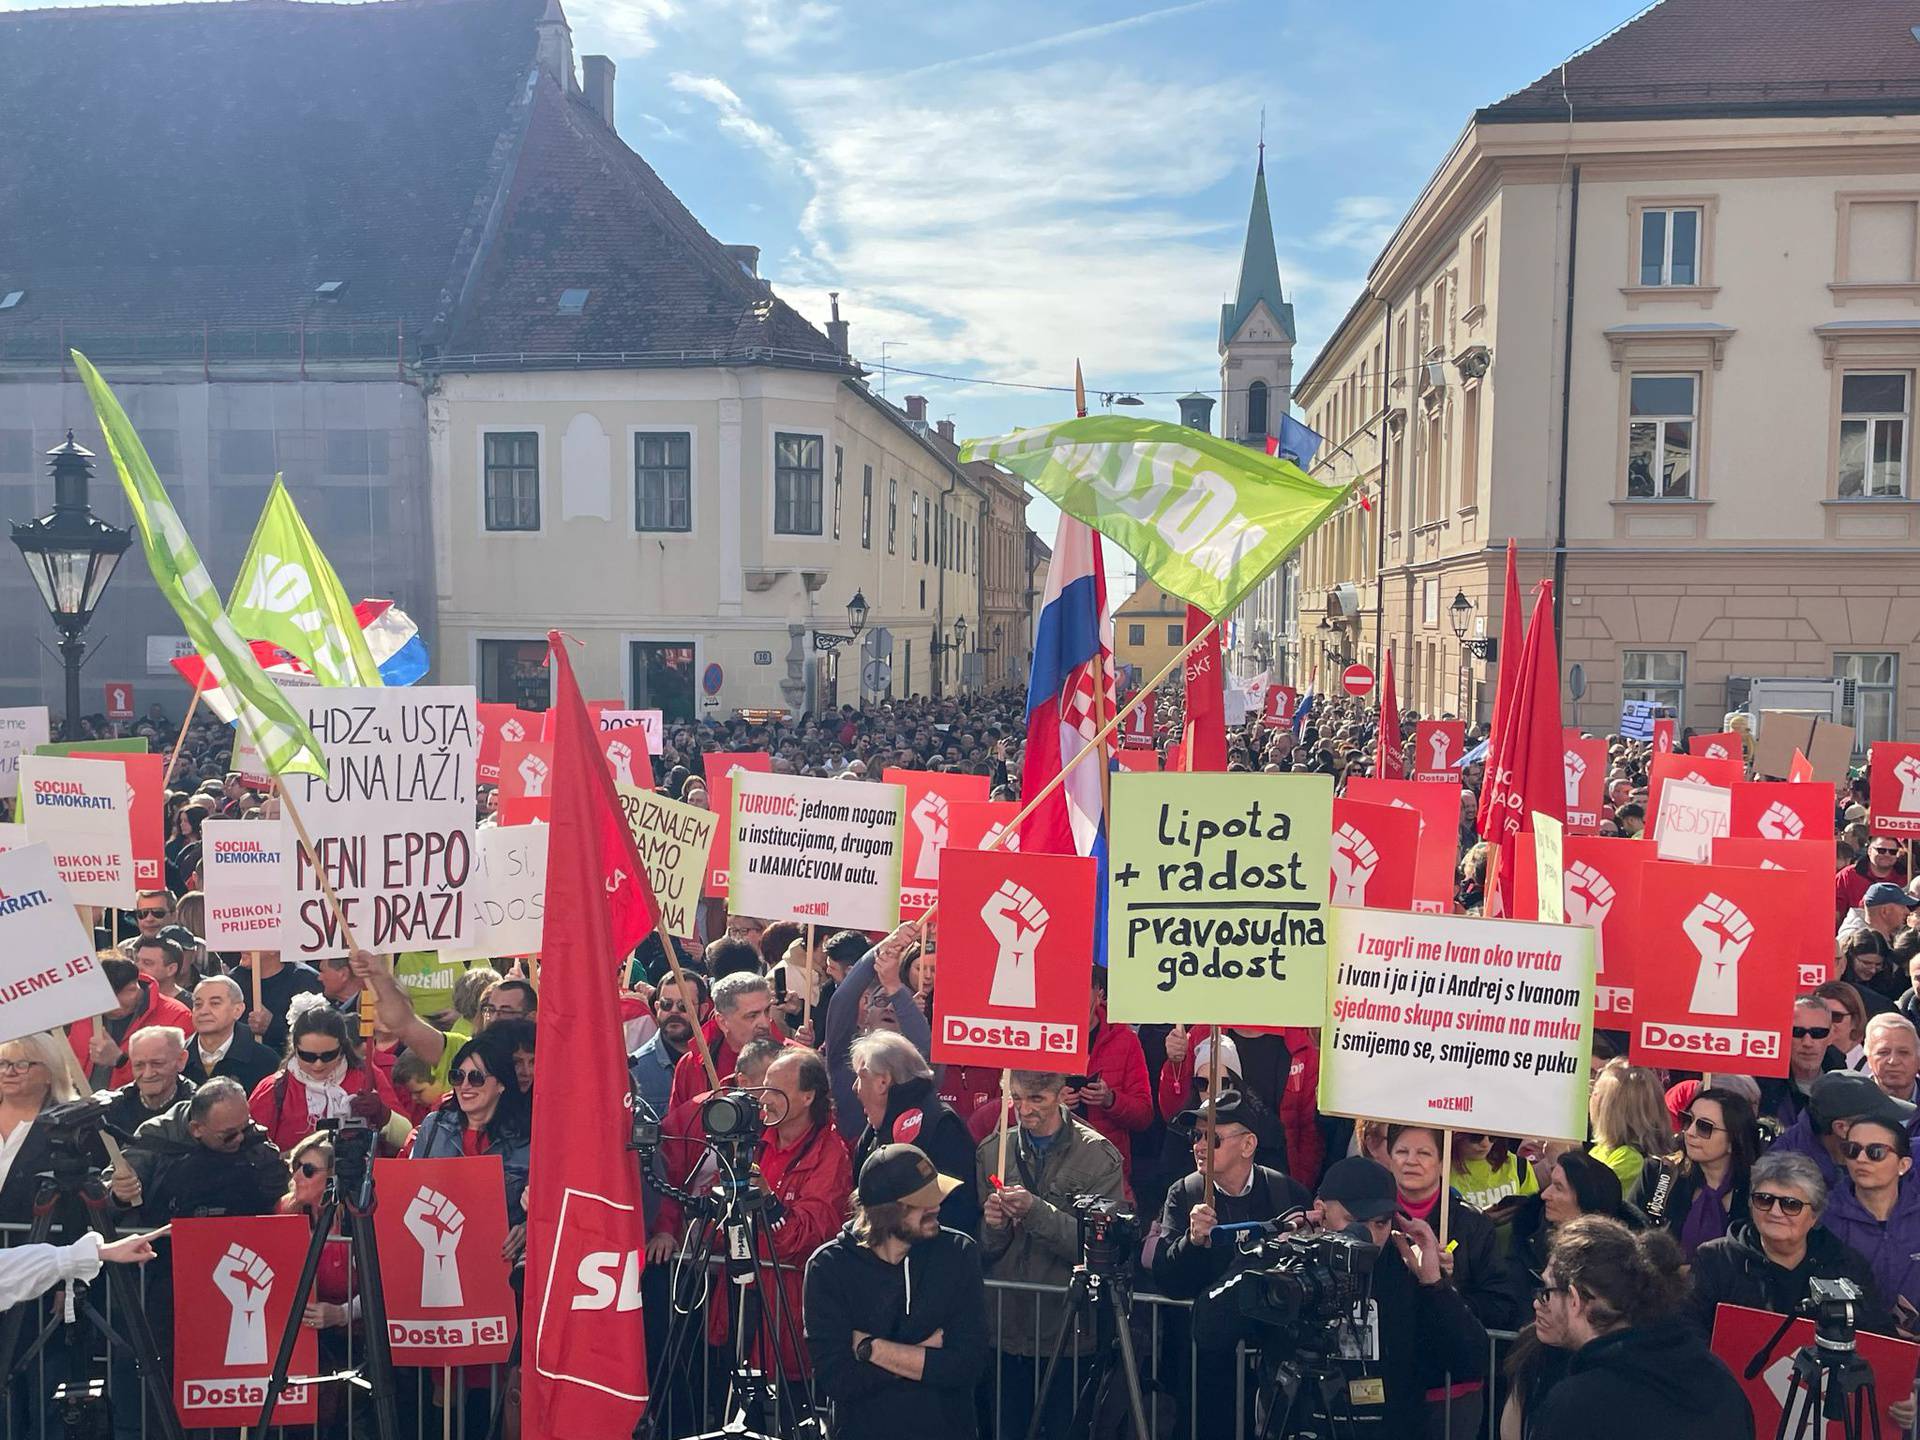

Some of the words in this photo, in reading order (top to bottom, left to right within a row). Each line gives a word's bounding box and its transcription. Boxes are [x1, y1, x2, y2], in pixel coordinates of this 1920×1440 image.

[309, 706, 392, 744] HDZ-u
[401, 704, 472, 748] USTA
[34, 780, 86, 795] SOCIJAL
[307, 753, 389, 803] PUNA
[396, 746, 465, 804] LAŽI,
[481, 766, 501, 777] Dos
[36, 793, 116, 810] DEMOKRATI.
[738, 792, 799, 817] TURUDIĆ:
[799, 798, 848, 822] jednom
[851, 808, 897, 829] nogom
[618, 793, 711, 850] PRIZNAJEM
[1666, 803, 1728, 836] RESISTA
[215, 841, 262, 852] SOCIJAL
[738, 826, 747, 842] u
[749, 823, 837, 854] institucijama,
[840, 832, 894, 858] drugom
[106, 854, 121, 866] JE
[296, 834, 366, 893] MENI
[382, 829, 470, 890] EPPO
[749, 857, 758, 873] u
[759, 854, 843, 882] MAMIĆEVOM
[844, 865, 878, 886] autu.
[1158, 850, 1307, 892] radost
[212, 904, 273, 919] RUBIKON
[299, 897, 360, 952] SVE
[373, 883, 463, 948] DRAŽI
[793, 901, 829, 917] MOŽEMO!
[1128, 912, 1326, 958] pravosudna
[67, 955, 94, 978] JE!
[1357, 932, 1365, 954] I
[1366, 935, 1414, 963] zagrli
[1415, 943, 1441, 961] me
[1444, 941, 1481, 965] Ivan
[1483, 944, 1513, 968] oko
[1516, 949, 1562, 972] vrata
[1157, 946, 1286, 992] gadost
[1337, 963, 1345, 984] i
[1346, 964, 1381, 989] Ivan
[1383, 967, 1391, 990] i
[1390, 969, 1408, 996] ja
[1410, 970, 1418, 992] i
[1417, 971, 1435, 998] ja
[1438, 972, 1446, 994] i
[1446, 974, 1503, 1005] Andrej
[1505, 983, 1514, 1001] s
[1517, 980, 1580, 1008] Ivanom
[946, 1020, 1030, 1048] Dosta
[1037, 1026, 1074, 1051] je!
[1333, 997, 1401, 1024] sjedamo
[1403, 1004, 1453, 1031] skupa
[1456, 1009, 1506, 1034] svima
[1509, 1016, 1530, 1036] na
[1533, 1017, 1582, 1042] muku
[1333, 1027, 1341, 1050] i
[1342, 1031, 1410, 1058] smijemo
[1413, 1040, 1435, 1064] se,
[1440, 1042, 1510, 1070] smijemo
[1513, 1051, 1532, 1069] se
[1534, 1051, 1578, 1076] puku
[1645, 1025, 1731, 1052] Dosta
[1740, 1033, 1776, 1056] je!
[1428, 1096, 1473, 1113] MOŽEMO!
[389, 1323, 464, 1344] Dosta
[470, 1321, 503, 1345] je!
[187, 1384, 264, 1405] Dosta
[280, 1385, 303, 1401] e!
